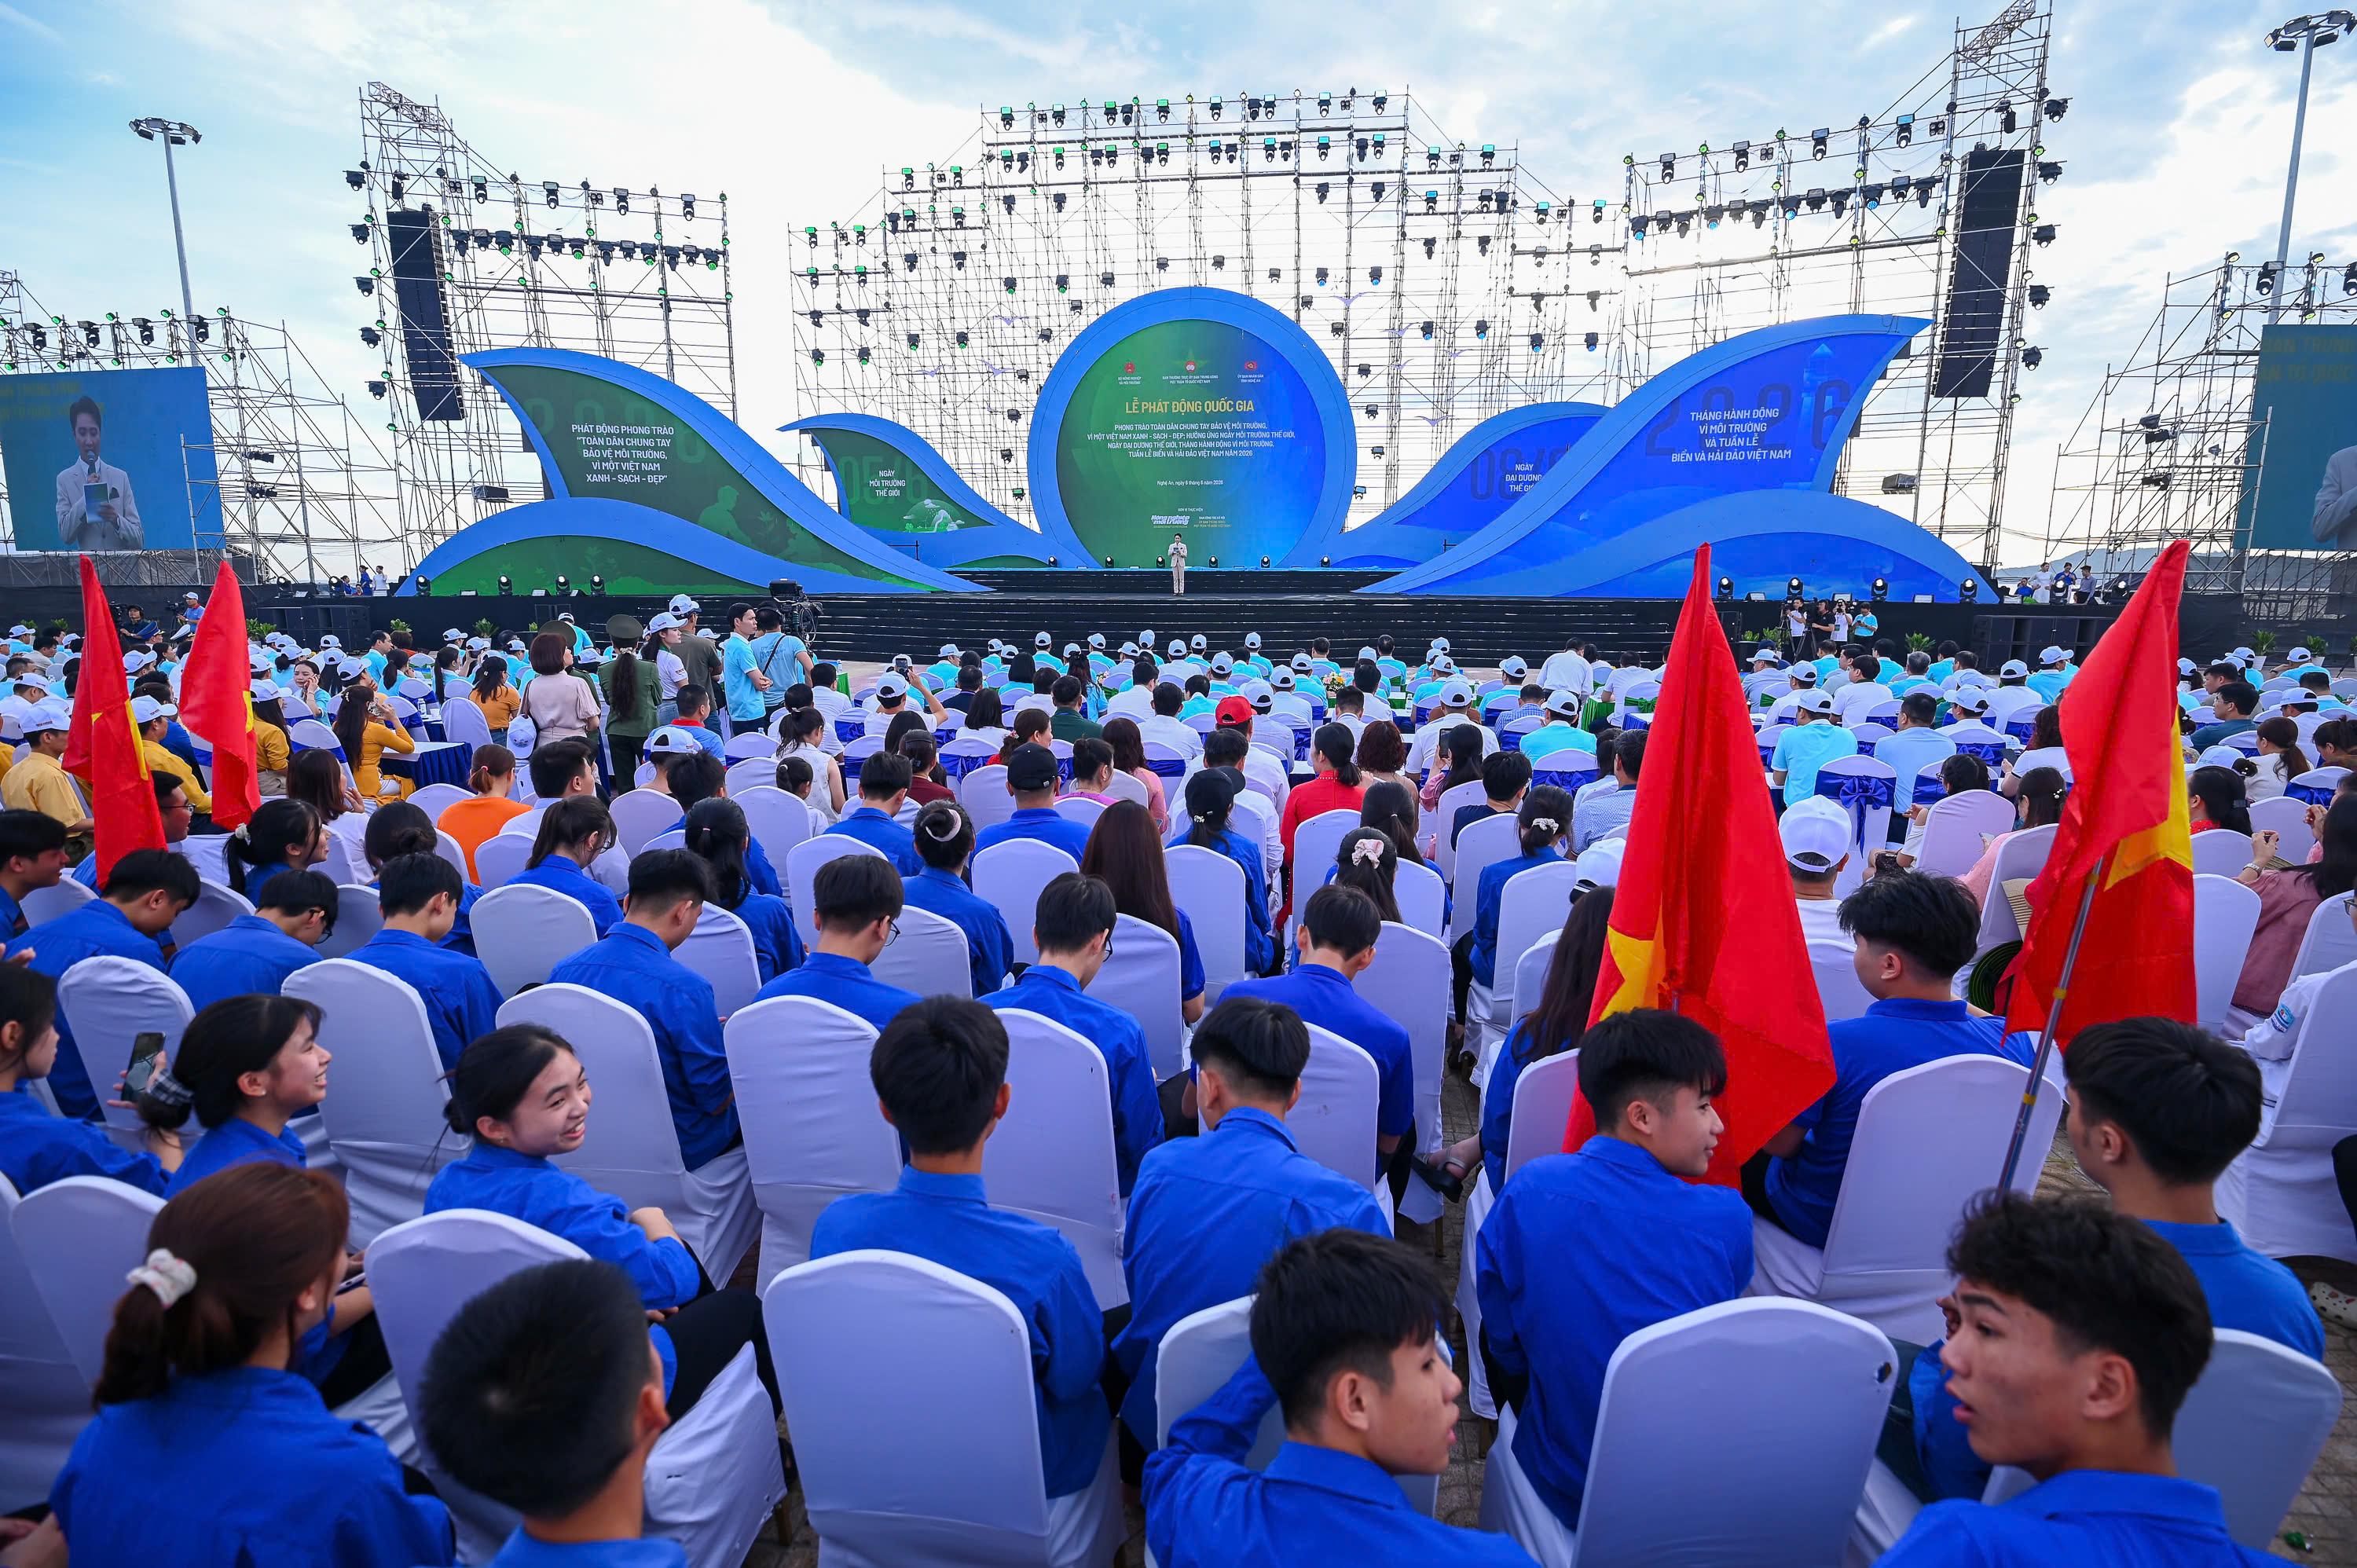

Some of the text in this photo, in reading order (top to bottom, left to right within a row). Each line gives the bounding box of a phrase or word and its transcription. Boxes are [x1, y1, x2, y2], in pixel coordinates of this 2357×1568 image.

[1125, 397, 1254, 415] LỄ PHÁT ĐỘNG QUỐC GIA
[1691, 407, 1779, 421] THÁNG HÀNH ĐỘNG
[572, 423, 594, 433] PHÁT
[596, 423, 619, 435] ĐỘNG
[651, 424, 674, 435] TRÀO
[1222, 422, 1230, 430] VỆ
[1699, 422, 1767, 434] VÌ MÔI TRƯỜNG
[607, 436, 624, 446] DÂN
[625, 438, 654, 446] CHUNG
[656, 438, 671, 447] TAY
[1094, 433, 1105, 441] MỘT
[1106, 432, 1118, 441] VIỆT
[1705, 433, 1758, 448] VÀ TUẦN LỄ
[1215, 440, 1231, 449] ĐỘNG
[583, 448, 667, 460] BẢO VỆ MÔI TRƯỜNG,
[1145, 449, 1152, 457] LỄ
[1153, 449, 1166, 457] BIỂN
[1198, 449, 1211, 458] VIỆT
[1672, 449, 1791, 462] BIỂN VÀ HẢI ĐẢO VIỆT NAM
[592, 460, 600, 470] VÌ
[602, 460, 620, 472] MỘT
[621, 460, 640, 472] VIỆT
[1516, 462, 1534, 471] NGÀY
[879, 468, 895, 477] NGÀY
[618, 474, 640, 485] SẠCH
[1505, 474, 1516, 483] ĐẠI
[875, 488, 887, 496] THẾ
[1509, 482, 1523, 492] THẾ
